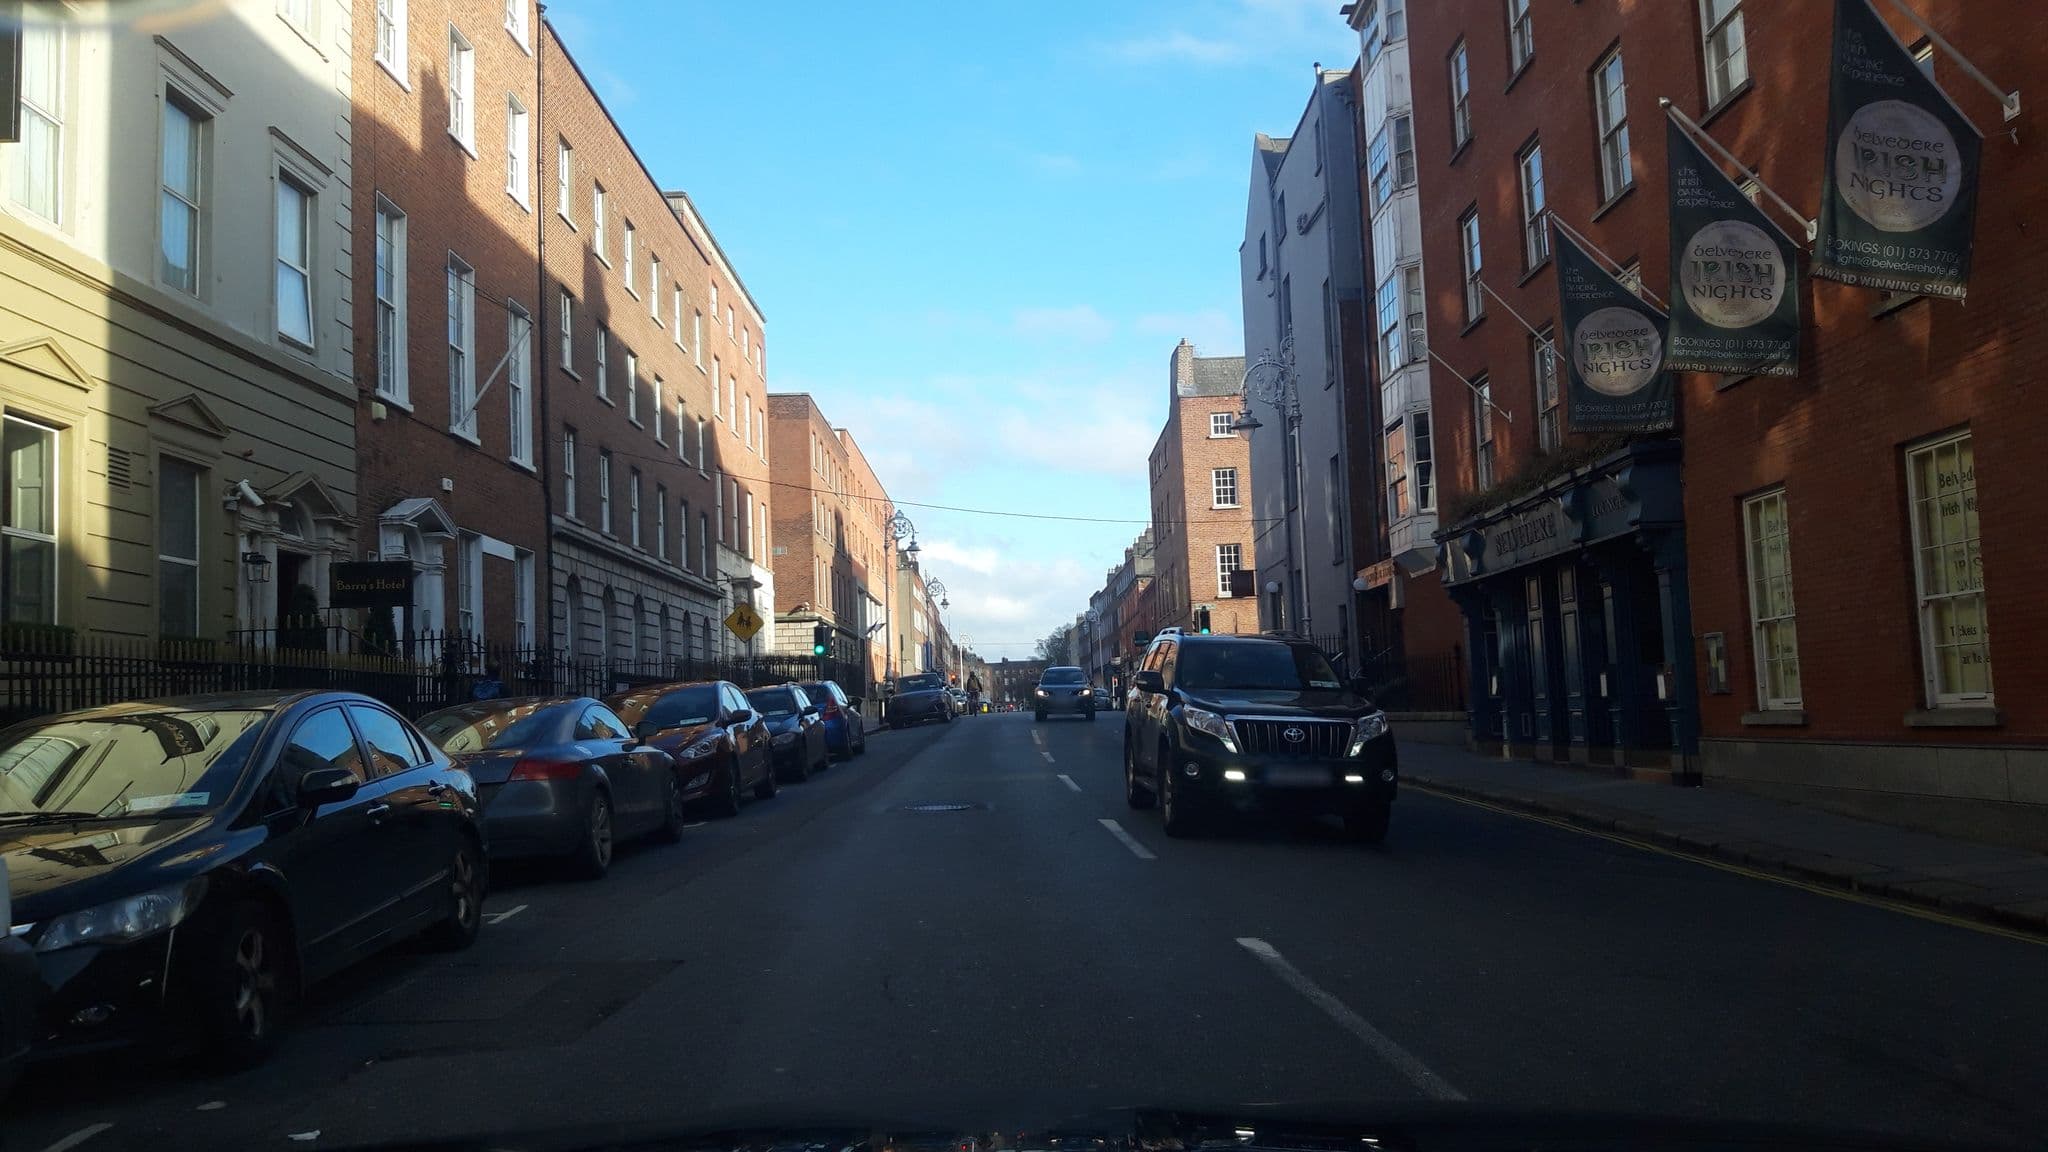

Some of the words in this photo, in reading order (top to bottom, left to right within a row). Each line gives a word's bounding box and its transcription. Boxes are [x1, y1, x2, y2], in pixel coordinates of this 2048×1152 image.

[1851, 142, 1948, 184] IRISH
[1850, 172, 1943, 202] NIGHTS
[1909, 248, 1930, 261] 873
[1691, 261, 1776, 286] IRISH
[1815, 267, 1857, 285] AWARD
[1860, 275, 1920, 292] WINNING
[1693, 285, 1773, 302] NIGHTS
[1583, 358, 1652, 376] NIGHTS
[376, 578, 406, 590] Hotel
